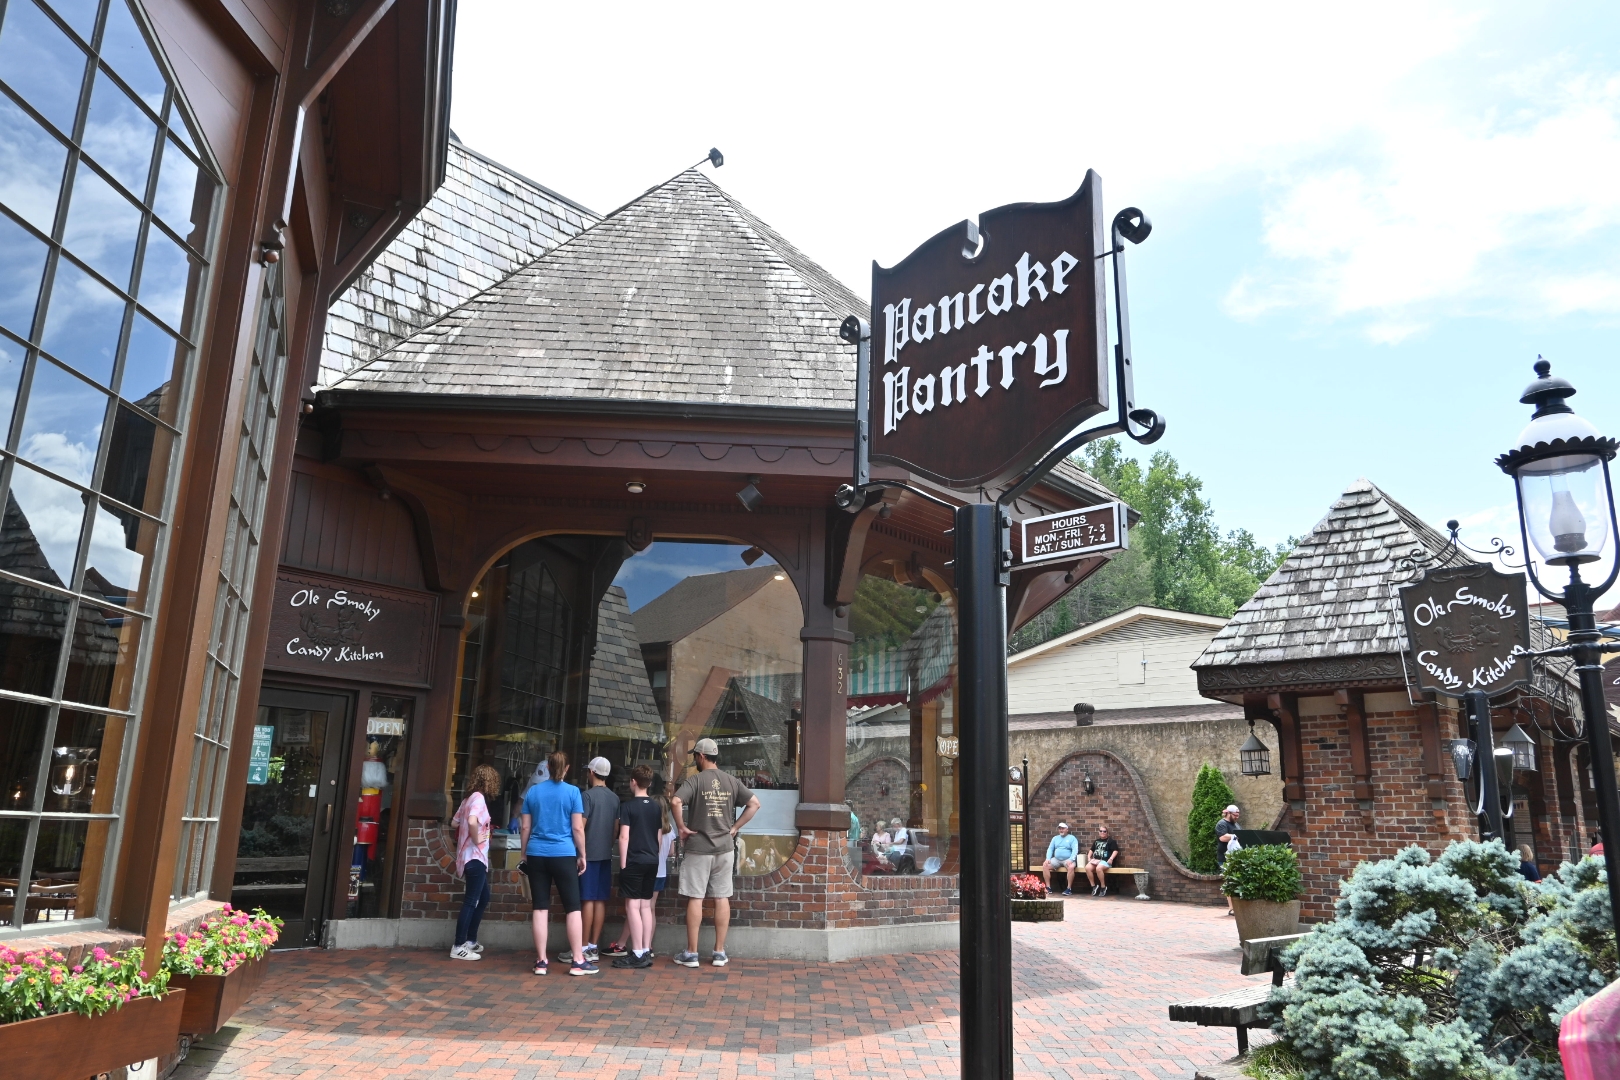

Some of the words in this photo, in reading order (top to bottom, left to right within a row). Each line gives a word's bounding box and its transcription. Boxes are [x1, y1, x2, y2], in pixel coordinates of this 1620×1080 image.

[883, 251, 1080, 365] Pancake
[882, 329, 1070, 436] Pantry
[1051, 515, 1087, 530] HOURS
[290, 589, 320, 607] Ole
[326, 590, 381, 622] Smoky
[1413, 596, 1447, 627] Ole
[1447, 586, 1517, 620] Smoky
[286, 637, 332, 661] Candy
[334, 645, 384, 662] Kitchen
[1417, 650, 1463, 690] Candy
[1467, 644, 1525, 689] Kitchen
[366, 718, 401, 735] OPEN
[940, 740, 959, 756] OPE
